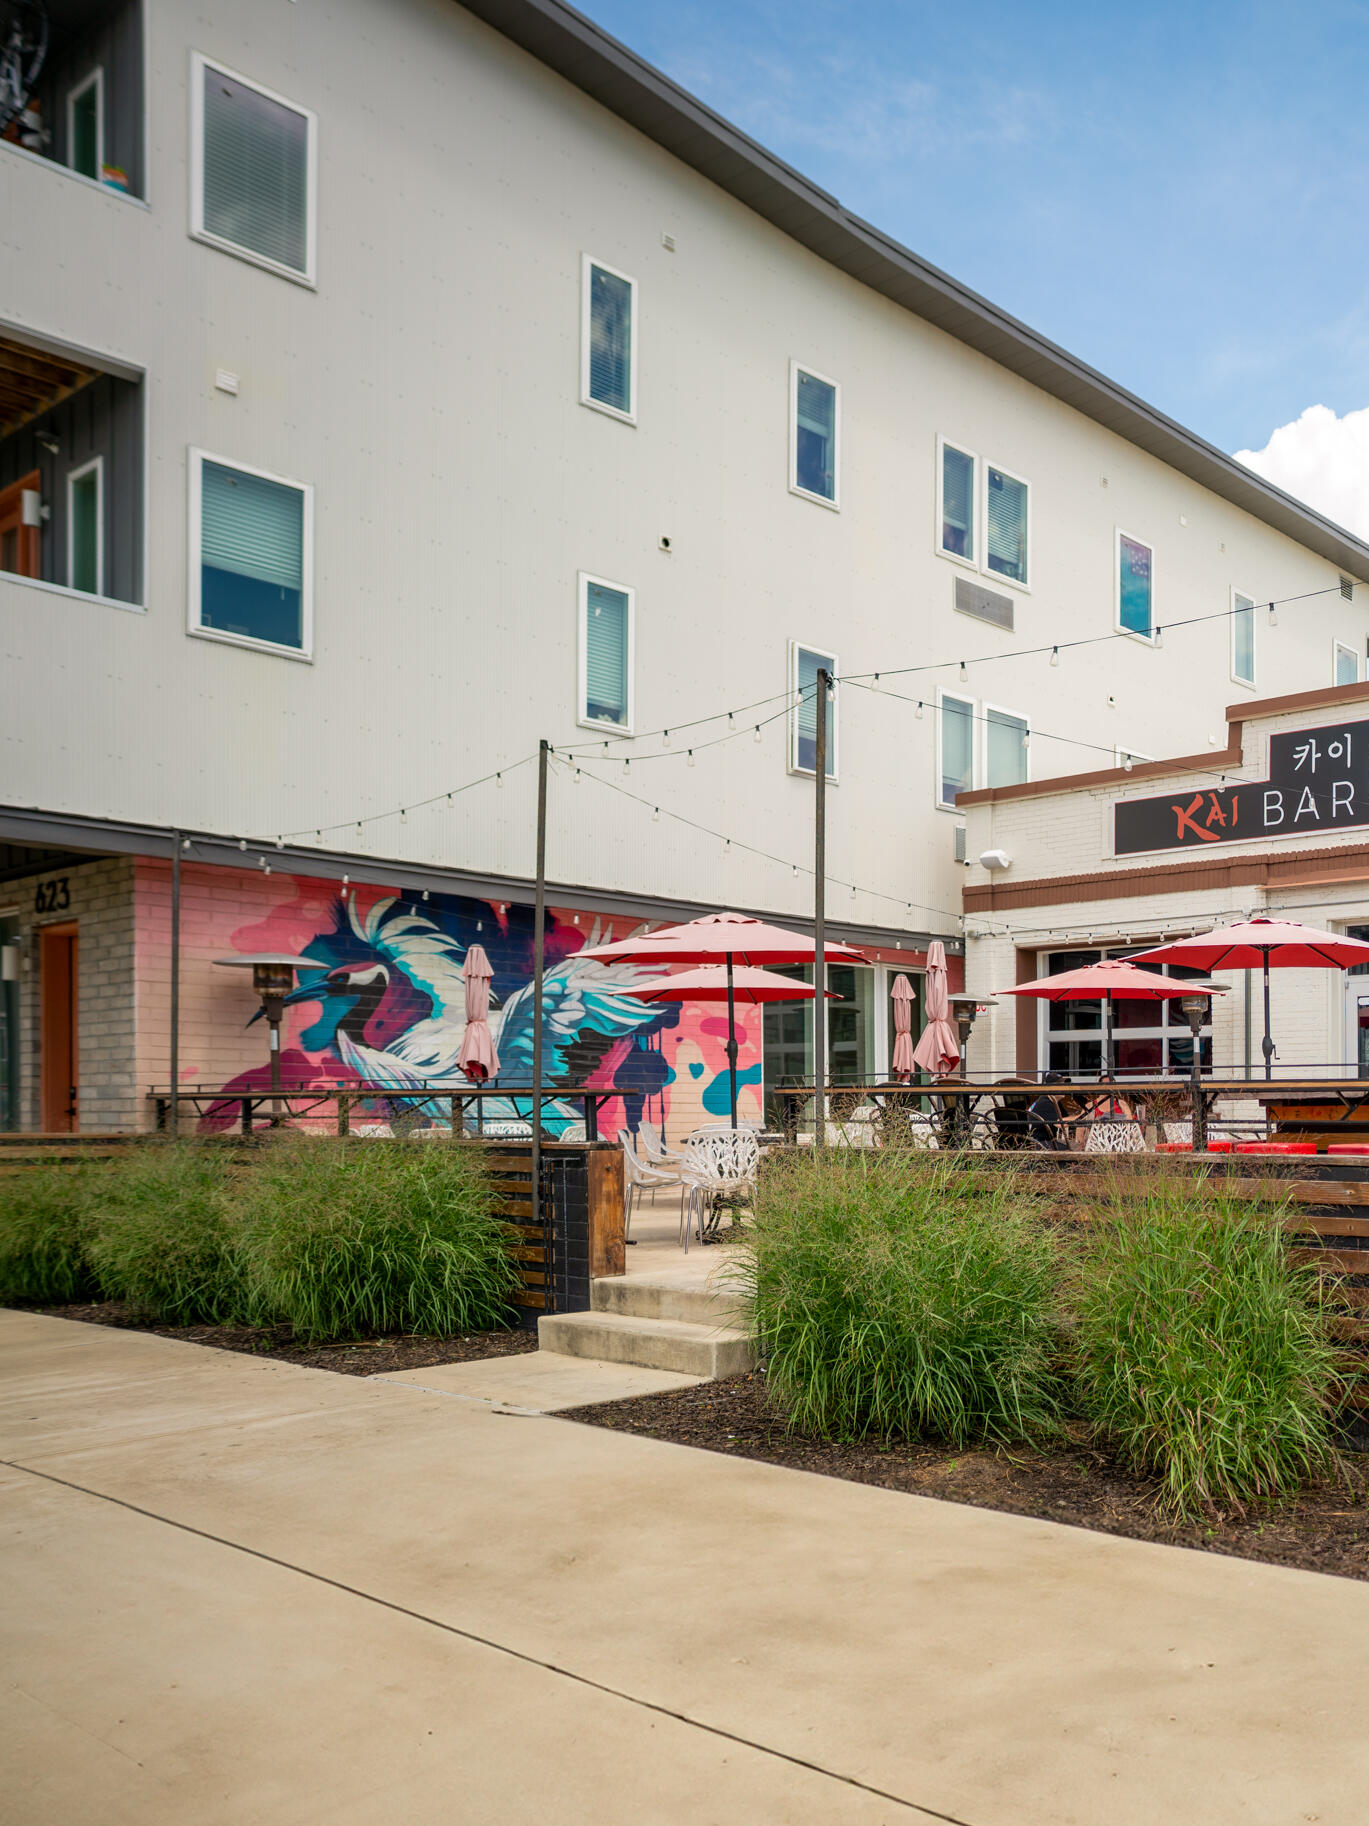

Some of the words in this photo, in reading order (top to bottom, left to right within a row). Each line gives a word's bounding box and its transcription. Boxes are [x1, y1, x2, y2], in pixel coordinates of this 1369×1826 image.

[1293, 733, 1352, 773] 카이
[1171, 792, 1239, 841] KAI
[1263, 781, 1355, 826] BAR
[35, 877, 70, 913] 623
